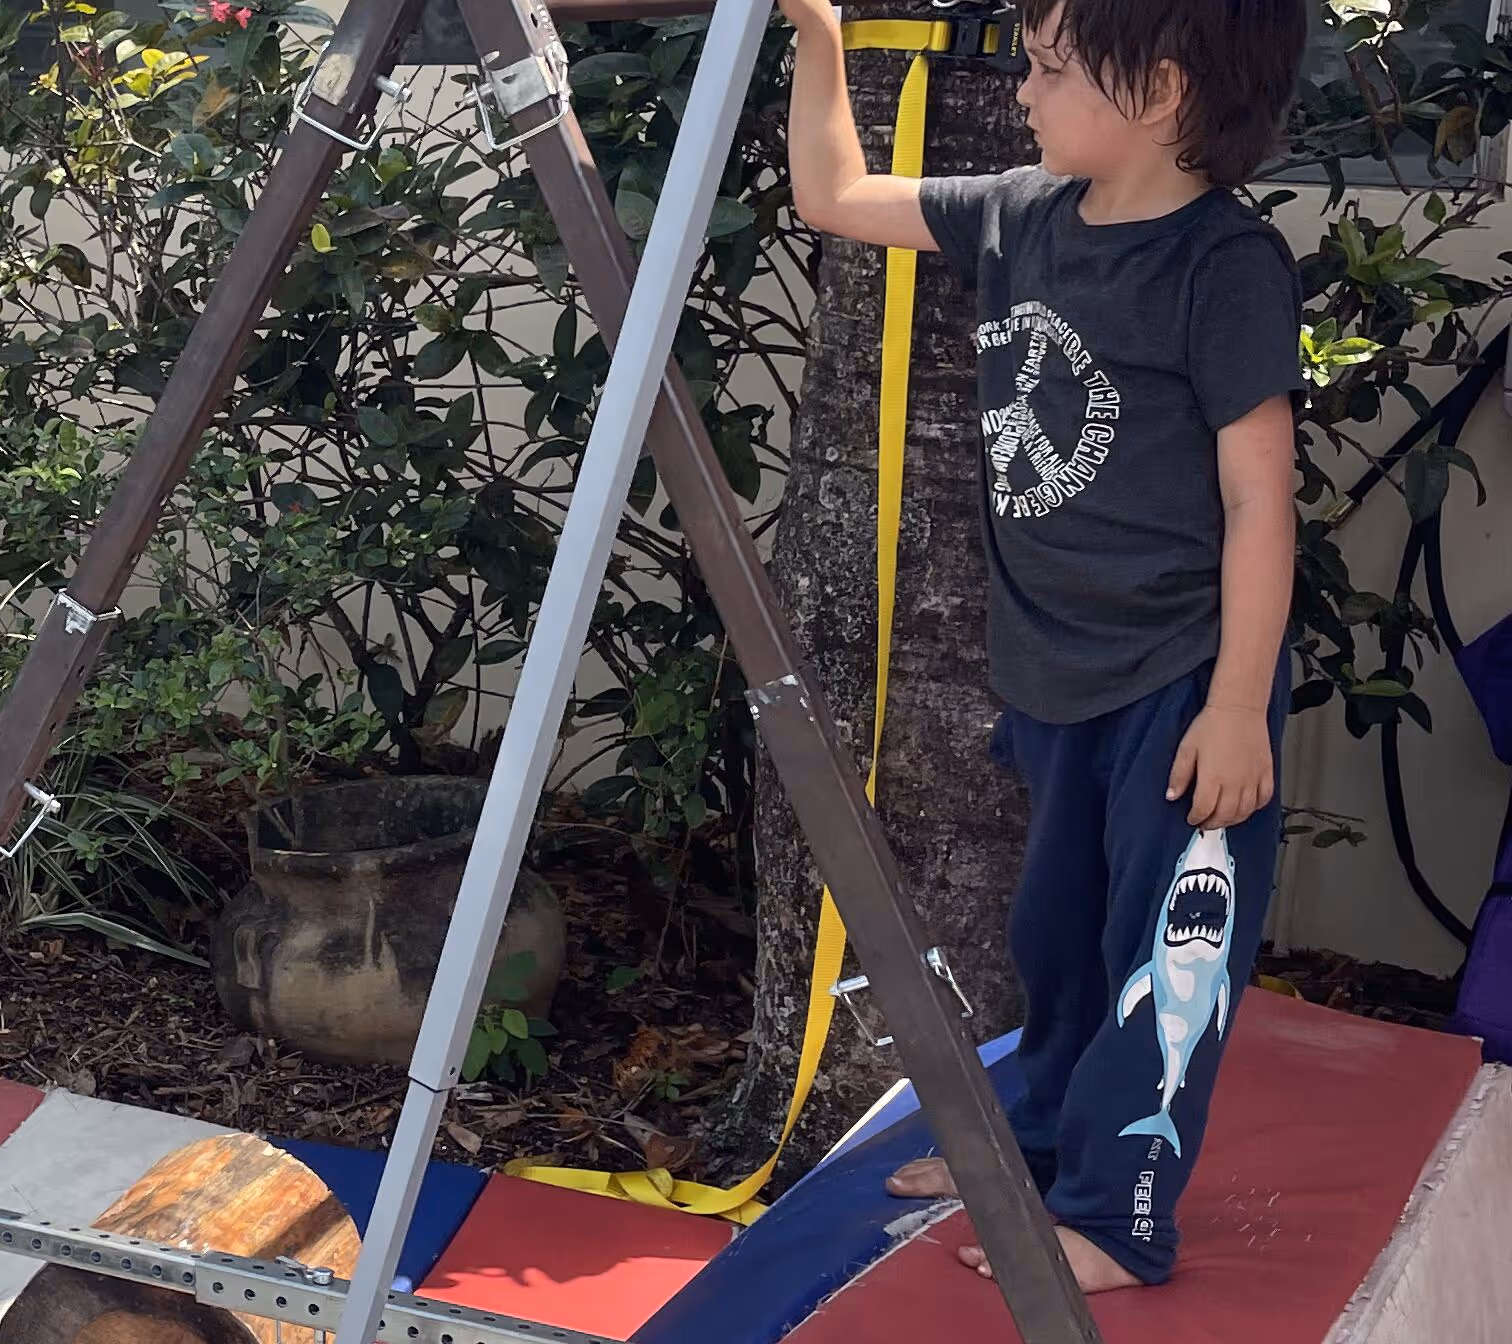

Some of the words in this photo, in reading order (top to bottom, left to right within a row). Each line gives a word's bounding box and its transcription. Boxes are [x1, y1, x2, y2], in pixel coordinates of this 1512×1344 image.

[1062, 333, 1093, 376] BE
[1082, 369, 1121, 420] THE
[1025, 422, 1115, 518] CHANGE
